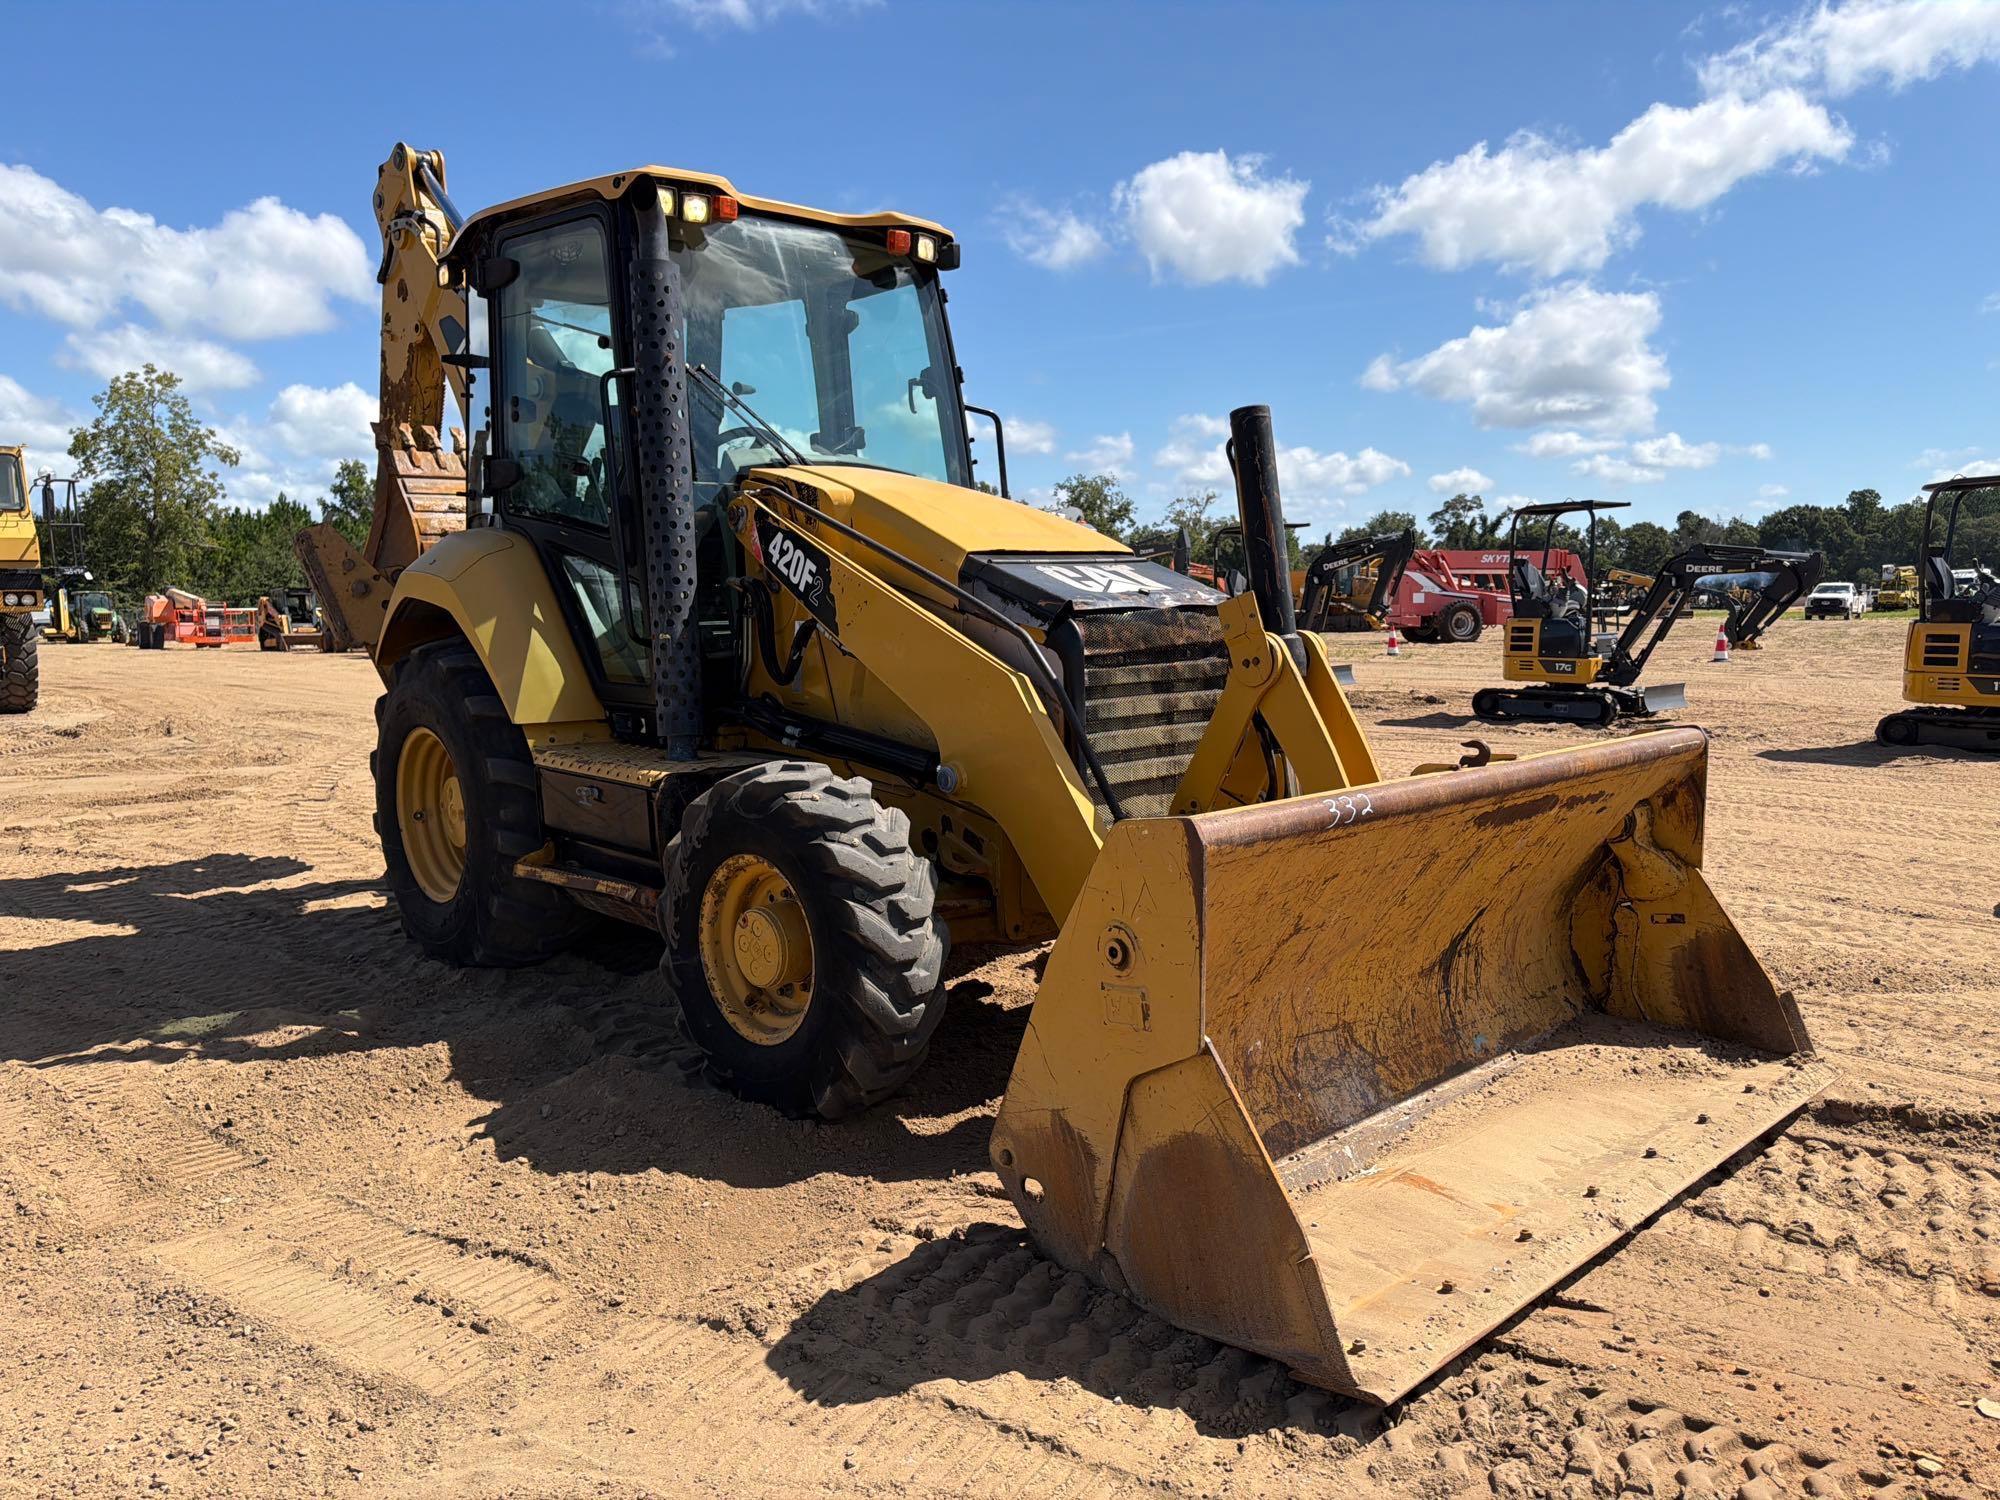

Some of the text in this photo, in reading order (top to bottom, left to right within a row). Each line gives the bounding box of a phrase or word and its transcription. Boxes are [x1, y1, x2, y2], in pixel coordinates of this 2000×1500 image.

[1322, 558, 1349, 571] DEERE
[1685, 564, 1723, 573] DEERE
[1035, 563, 1173, 593] CAT
[1555, 663, 1572, 671] 17G
[1322, 793, 1374, 829] 332
